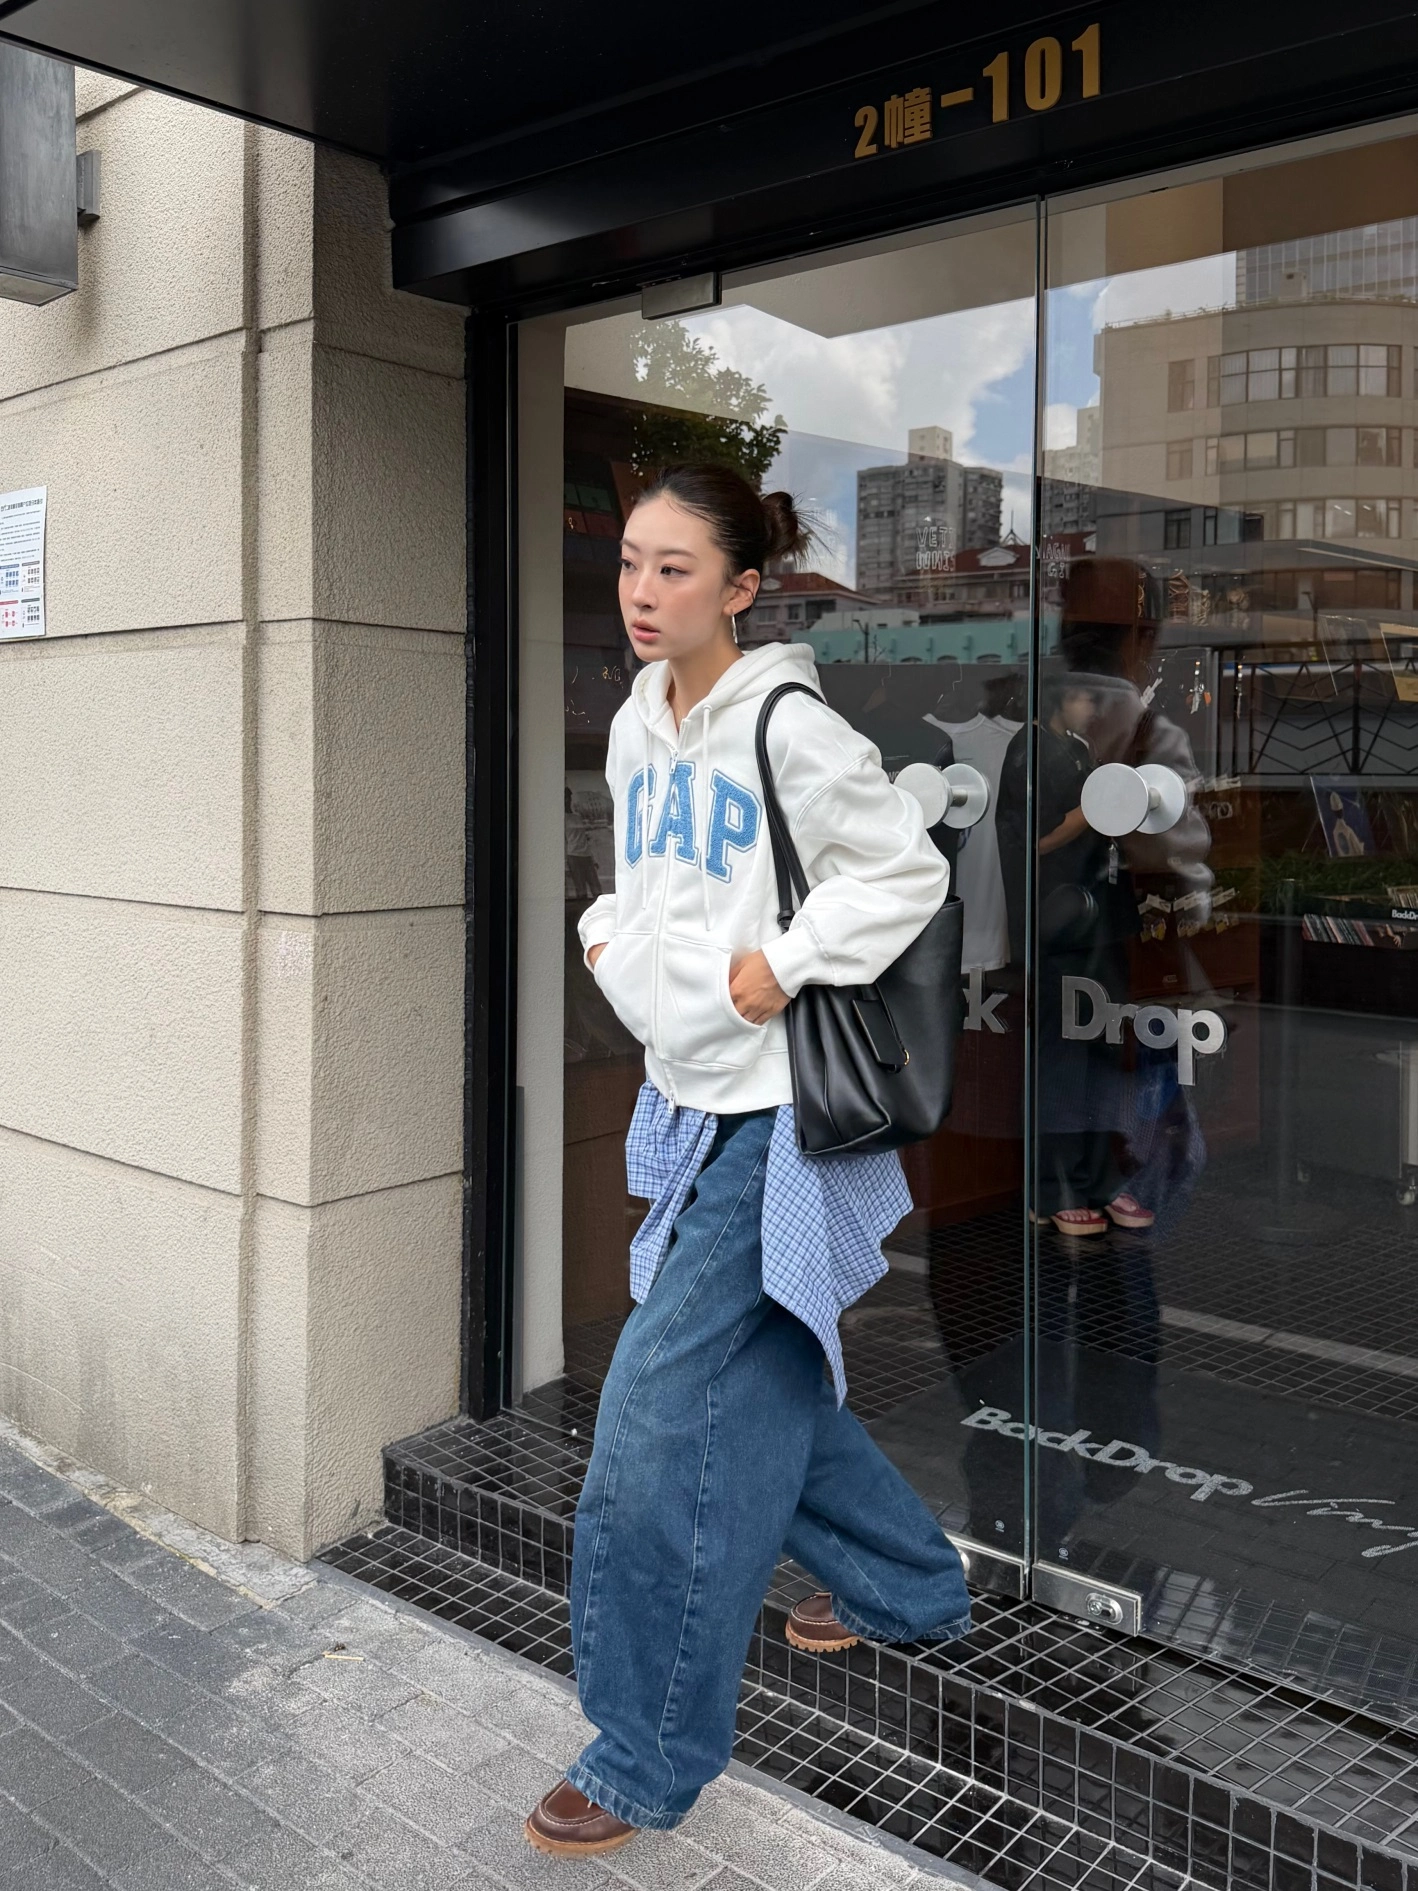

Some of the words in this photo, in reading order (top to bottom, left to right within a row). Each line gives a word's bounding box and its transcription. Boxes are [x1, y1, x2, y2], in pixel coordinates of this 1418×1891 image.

[625, 760, 762, 884] GAP
[962, 966, 1009, 1035] k
[1061, 975, 1228, 1086] Drop
[959, 1405, 1254, 1502] BackDrop
